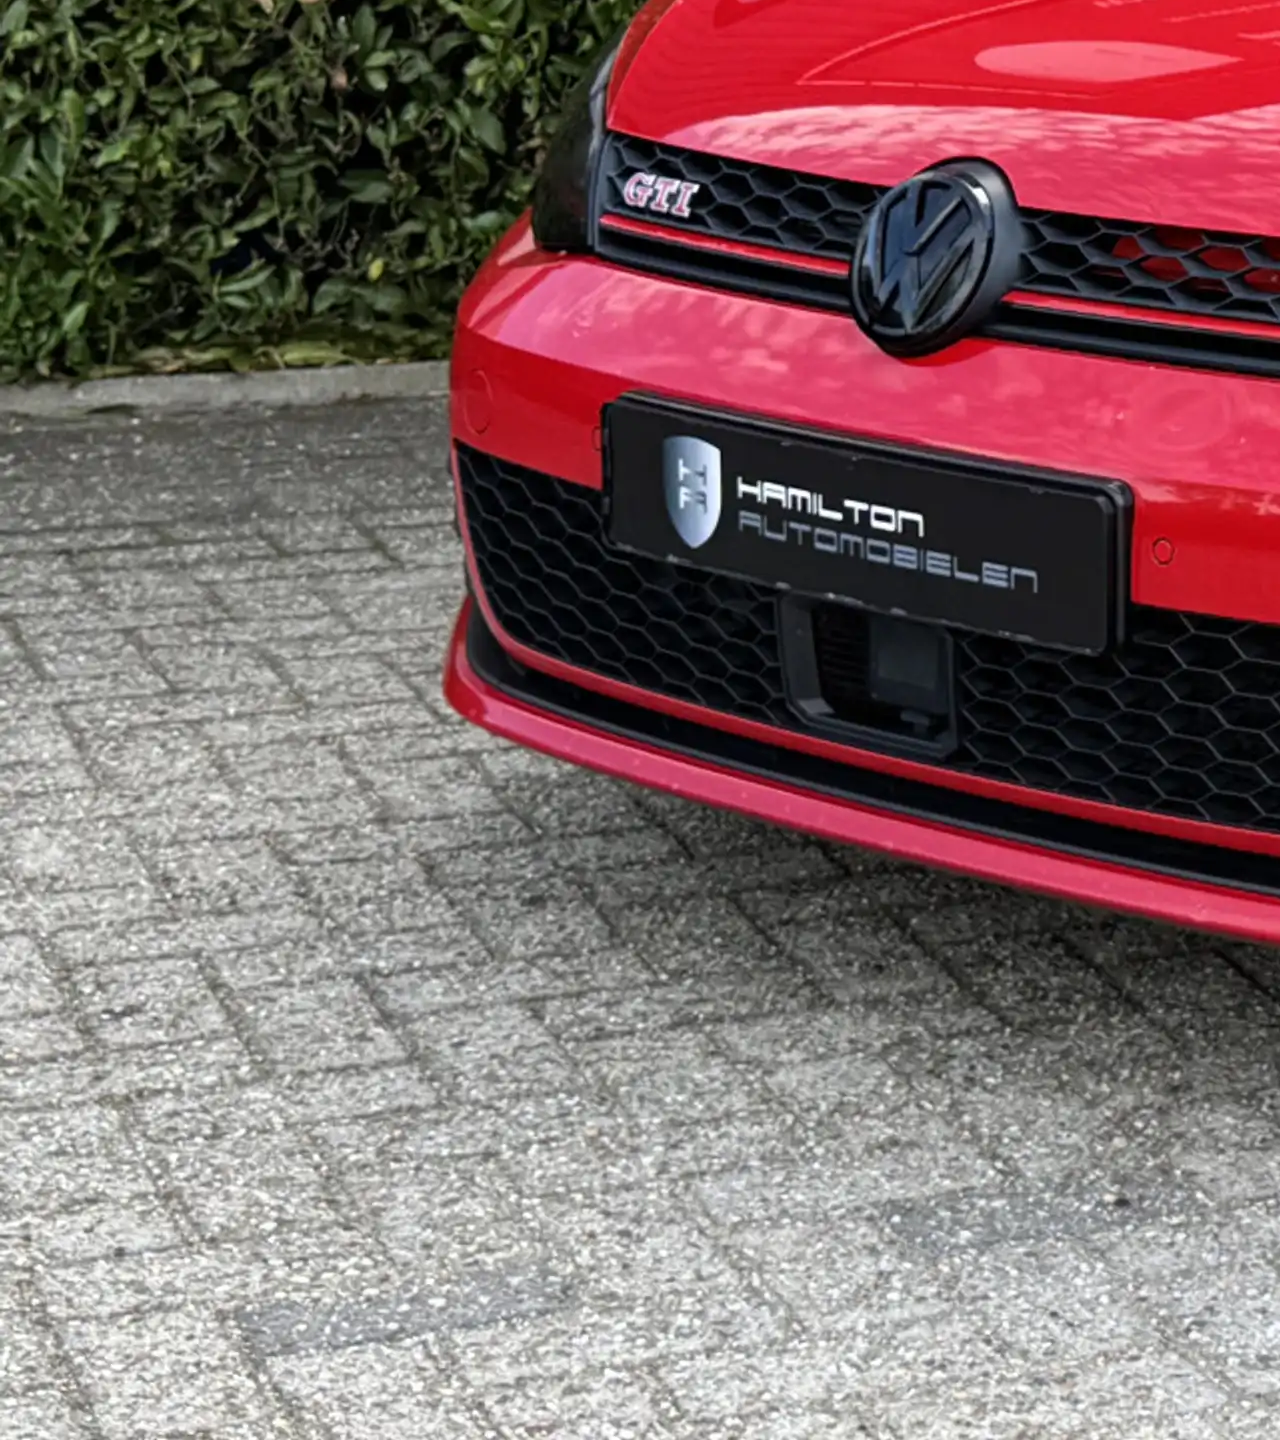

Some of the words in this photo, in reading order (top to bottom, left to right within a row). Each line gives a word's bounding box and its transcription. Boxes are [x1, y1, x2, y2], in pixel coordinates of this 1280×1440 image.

[624, 171, 700, 218] GTI
[737, 475, 925, 538] HAMILTON
[737, 510, 1038, 594] AUTOMOBIELEN
